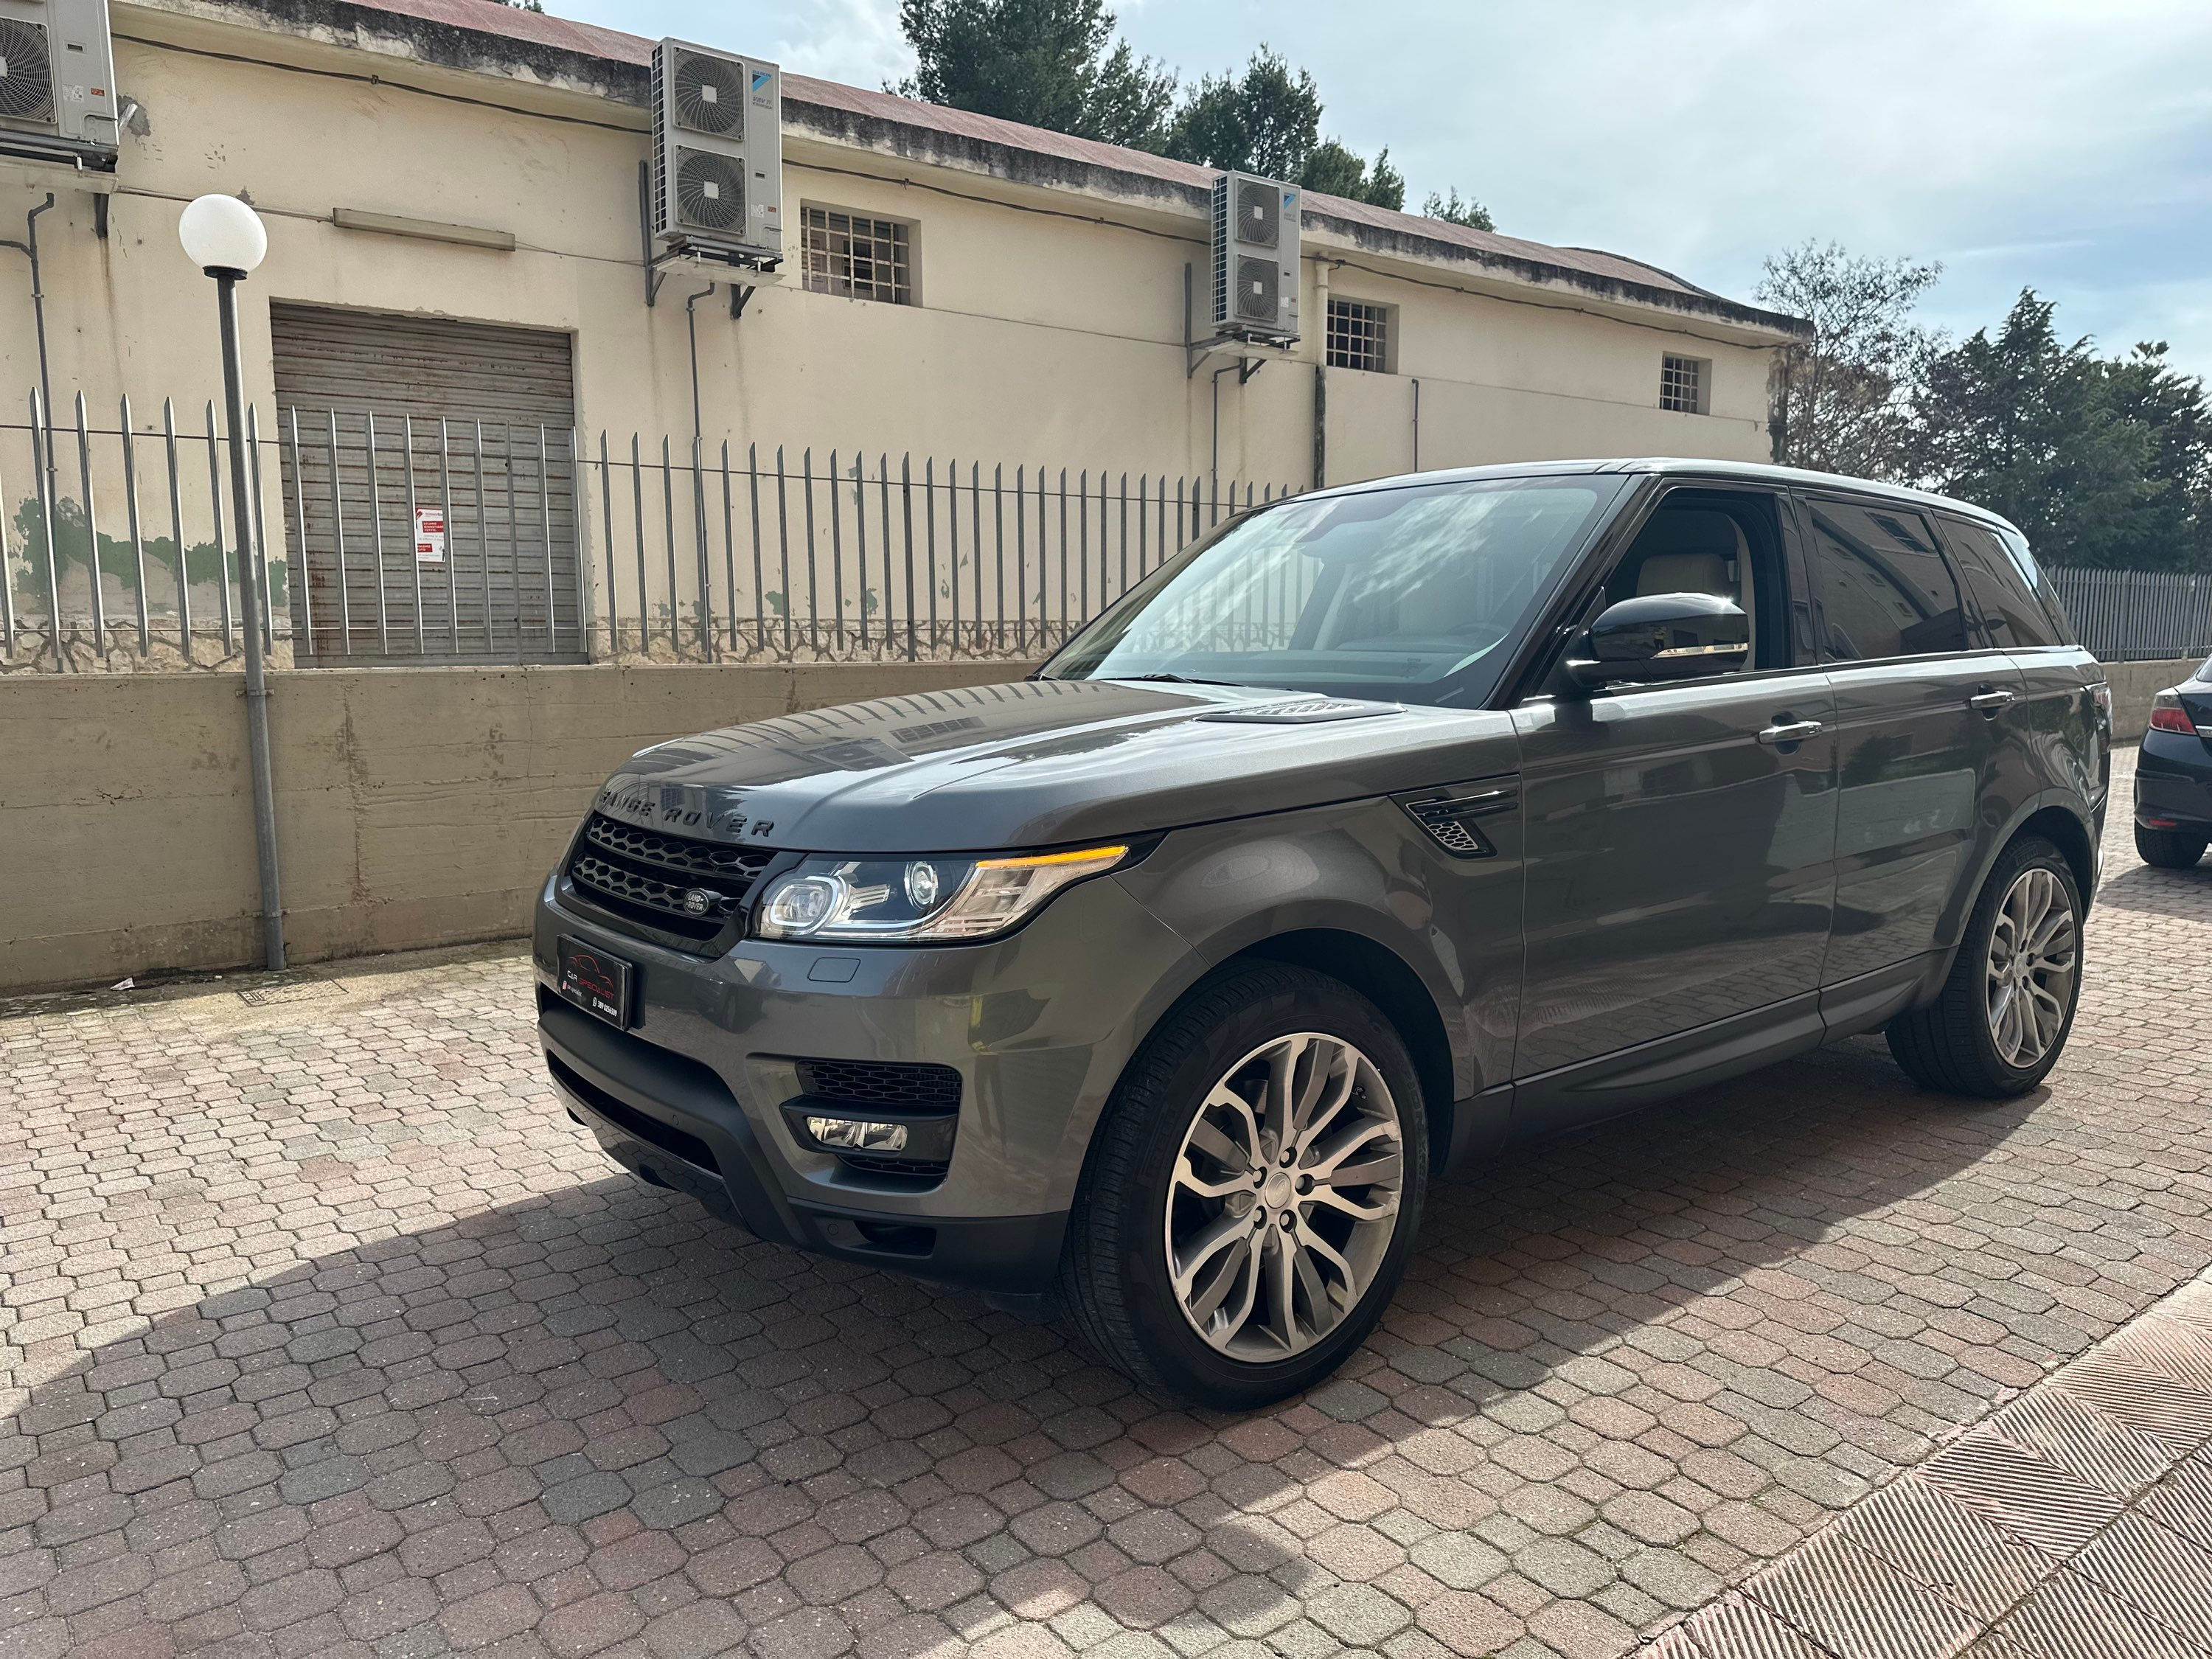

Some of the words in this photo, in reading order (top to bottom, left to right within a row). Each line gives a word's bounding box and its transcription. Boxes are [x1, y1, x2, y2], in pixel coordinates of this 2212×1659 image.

[599, 791, 655, 817] RANGE
[665, 807, 774, 838] ROVER
[686, 900, 703, 911] ROVER
[688, 894, 701, 902] LAND
[567, 970, 578, 982] CAR
[578, 978, 614, 1000] SPECIALIST
